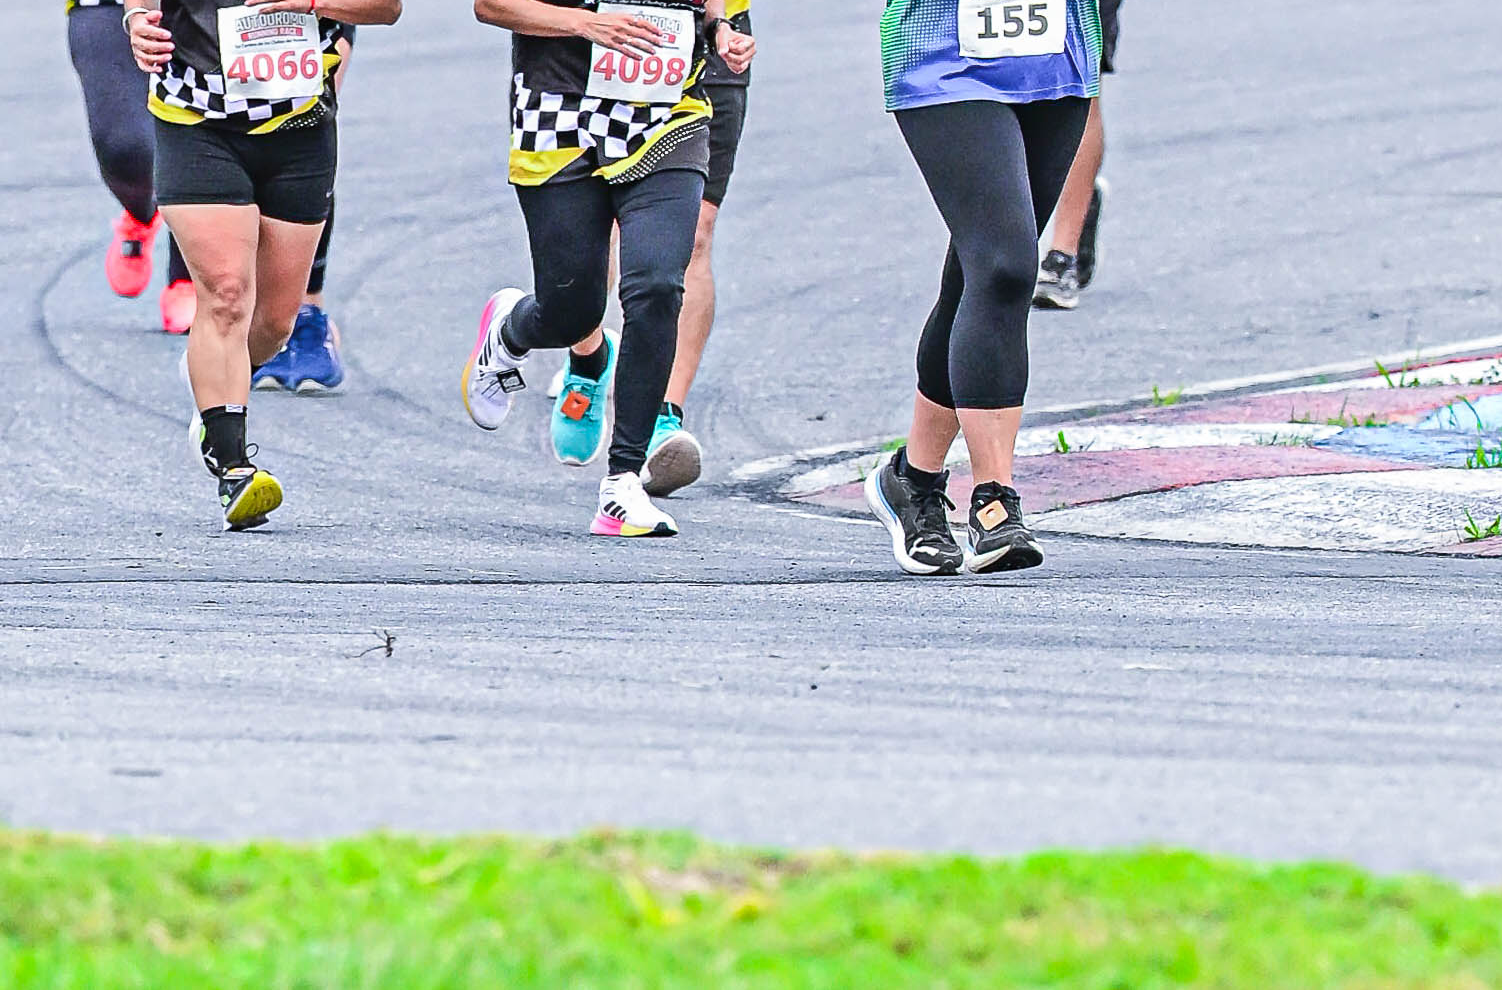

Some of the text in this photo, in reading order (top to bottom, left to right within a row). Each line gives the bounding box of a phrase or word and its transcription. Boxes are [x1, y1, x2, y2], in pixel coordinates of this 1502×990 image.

[977, 3, 1048, 39] 155
[227, 49, 318, 84] 4066
[593, 52, 685, 86] 4098
